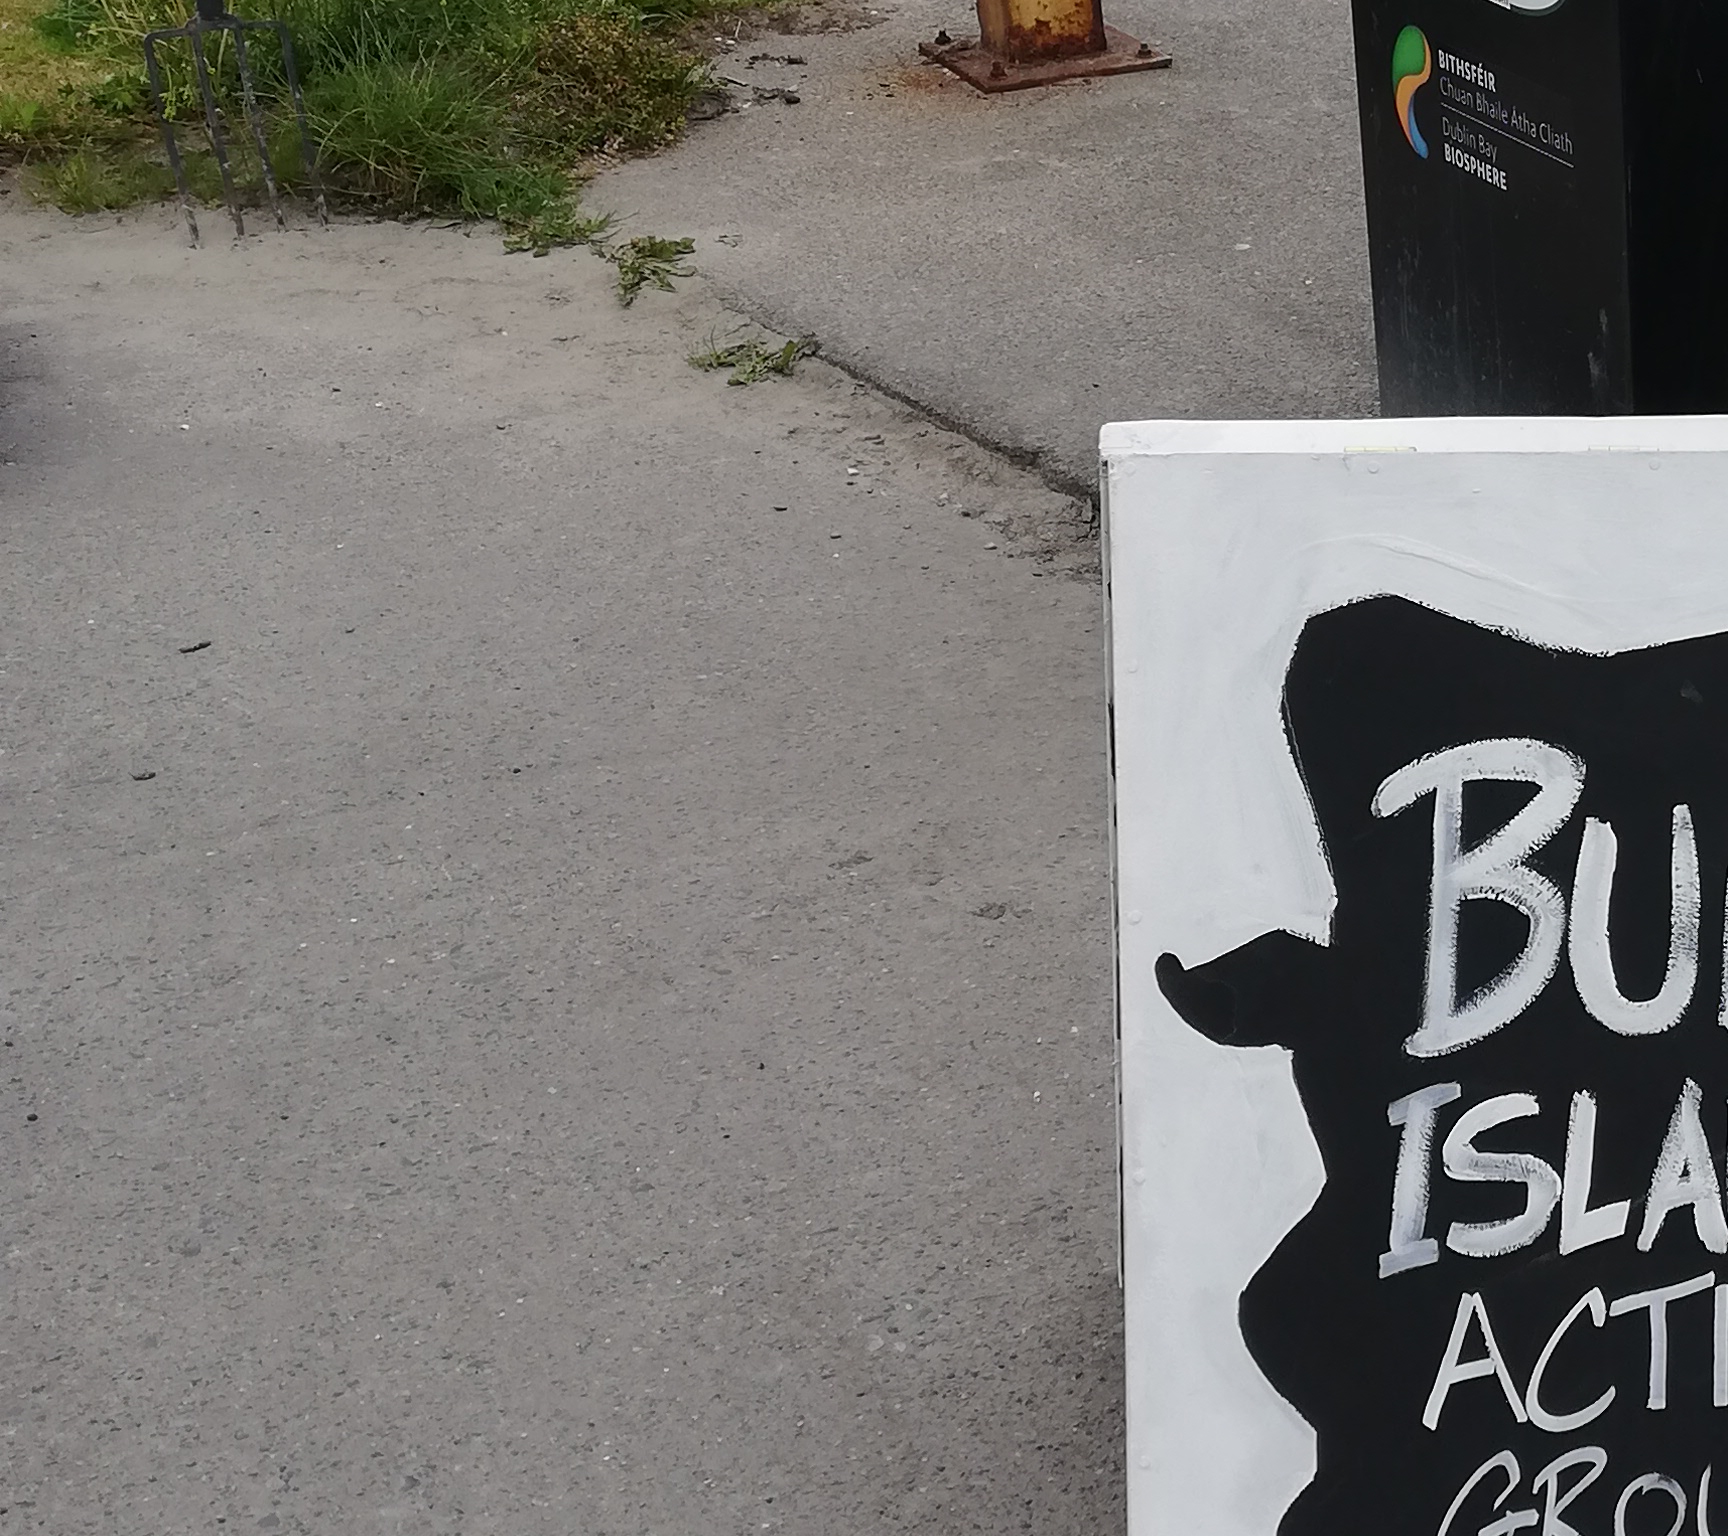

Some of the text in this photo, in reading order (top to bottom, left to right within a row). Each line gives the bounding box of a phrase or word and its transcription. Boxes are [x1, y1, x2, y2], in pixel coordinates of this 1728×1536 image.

[1438, 49, 1496, 93] BITHSFÉIR
[1440, 76, 1473, 107] Chuan
[1476, 91, 1509, 125] Bhaile
[1539, 122, 1574, 155] Cliath
[1442, 117, 1498, 163] Dublin Bay
[1444, 143, 1507, 190] BIOSPHERE
